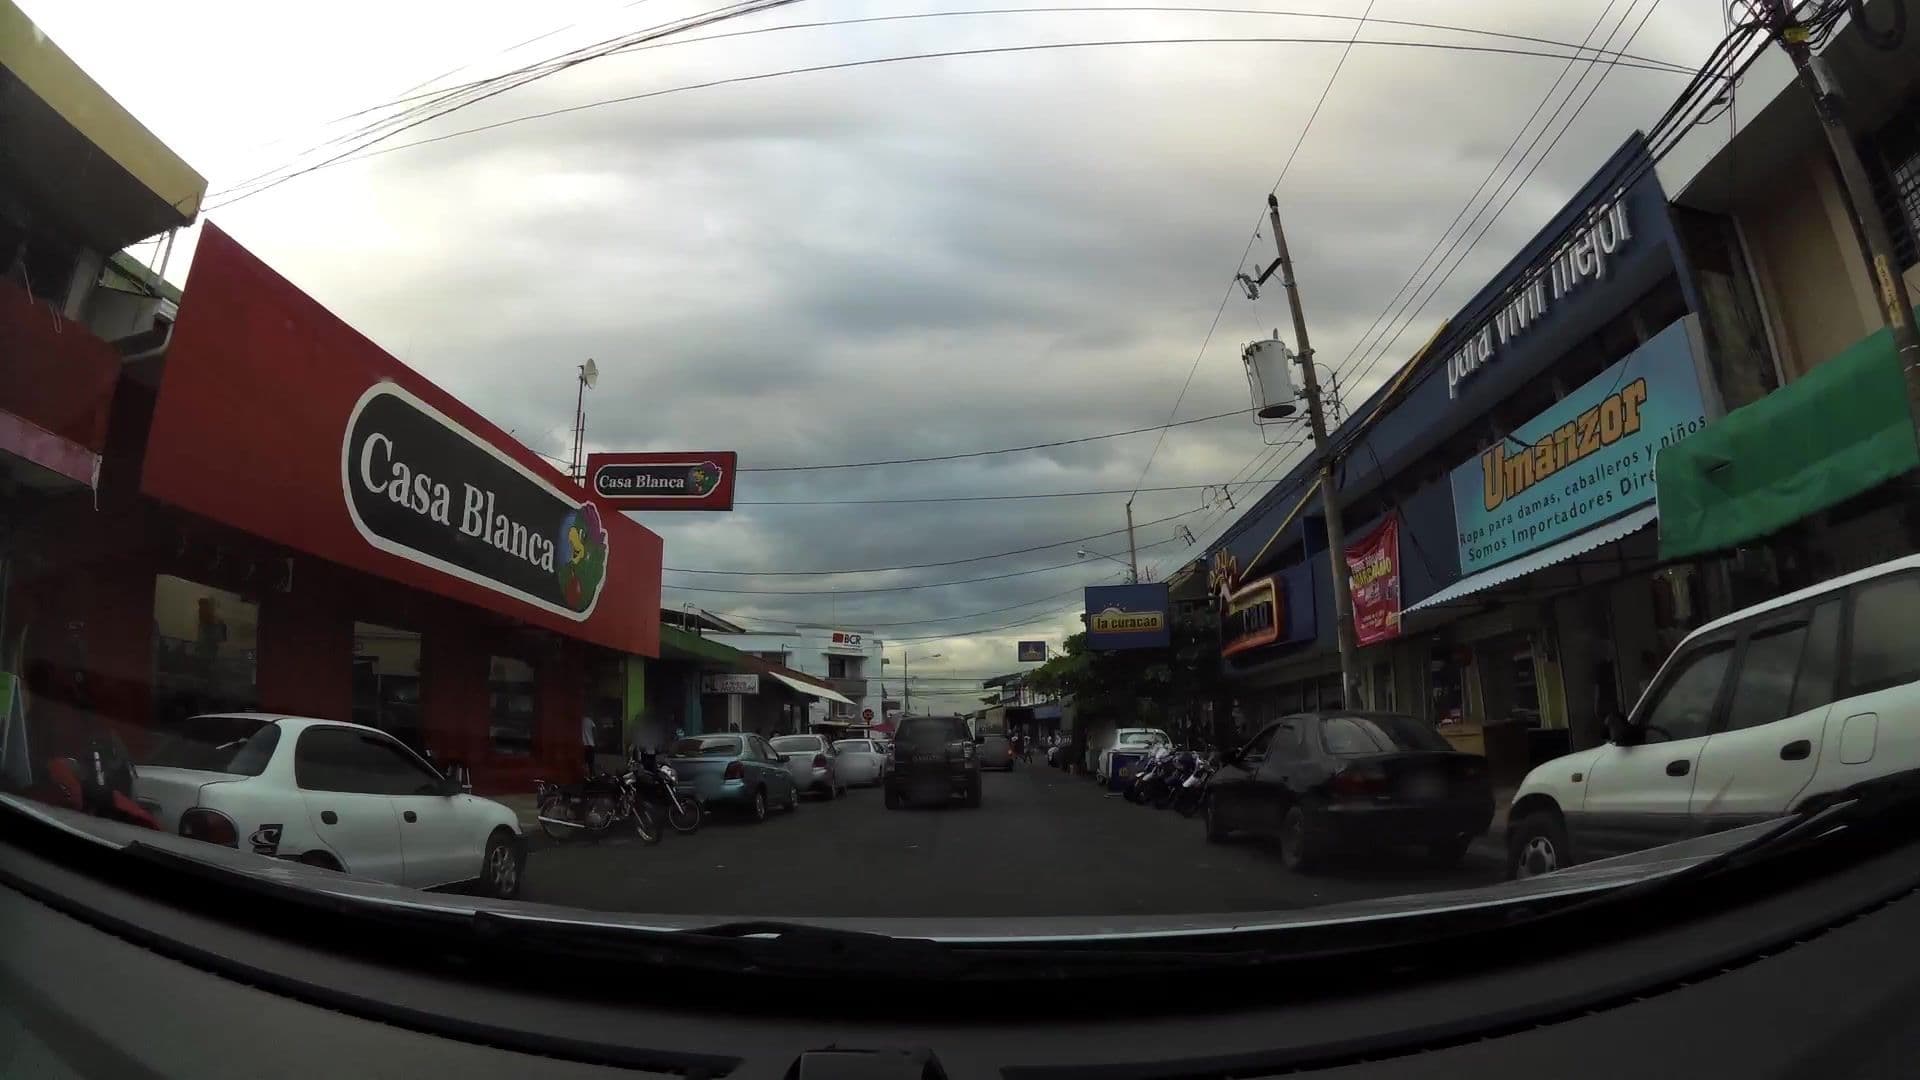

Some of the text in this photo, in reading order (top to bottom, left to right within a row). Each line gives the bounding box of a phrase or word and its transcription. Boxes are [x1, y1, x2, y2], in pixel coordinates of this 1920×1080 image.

[1480, 377, 1648, 512] Umanzor
[360, 432, 556, 573] Casa Blanca
[599, 475, 684, 488] Casa Blanca
[1460, 415, 1706, 547] Ropa para damas, caballeros y niños
[1468, 538, 1507, 562] Somos
[1512, 490, 1612, 544] Importadores
[844, 633, 862, 645] BCR
[1097, 616, 1157, 629] la curacao
